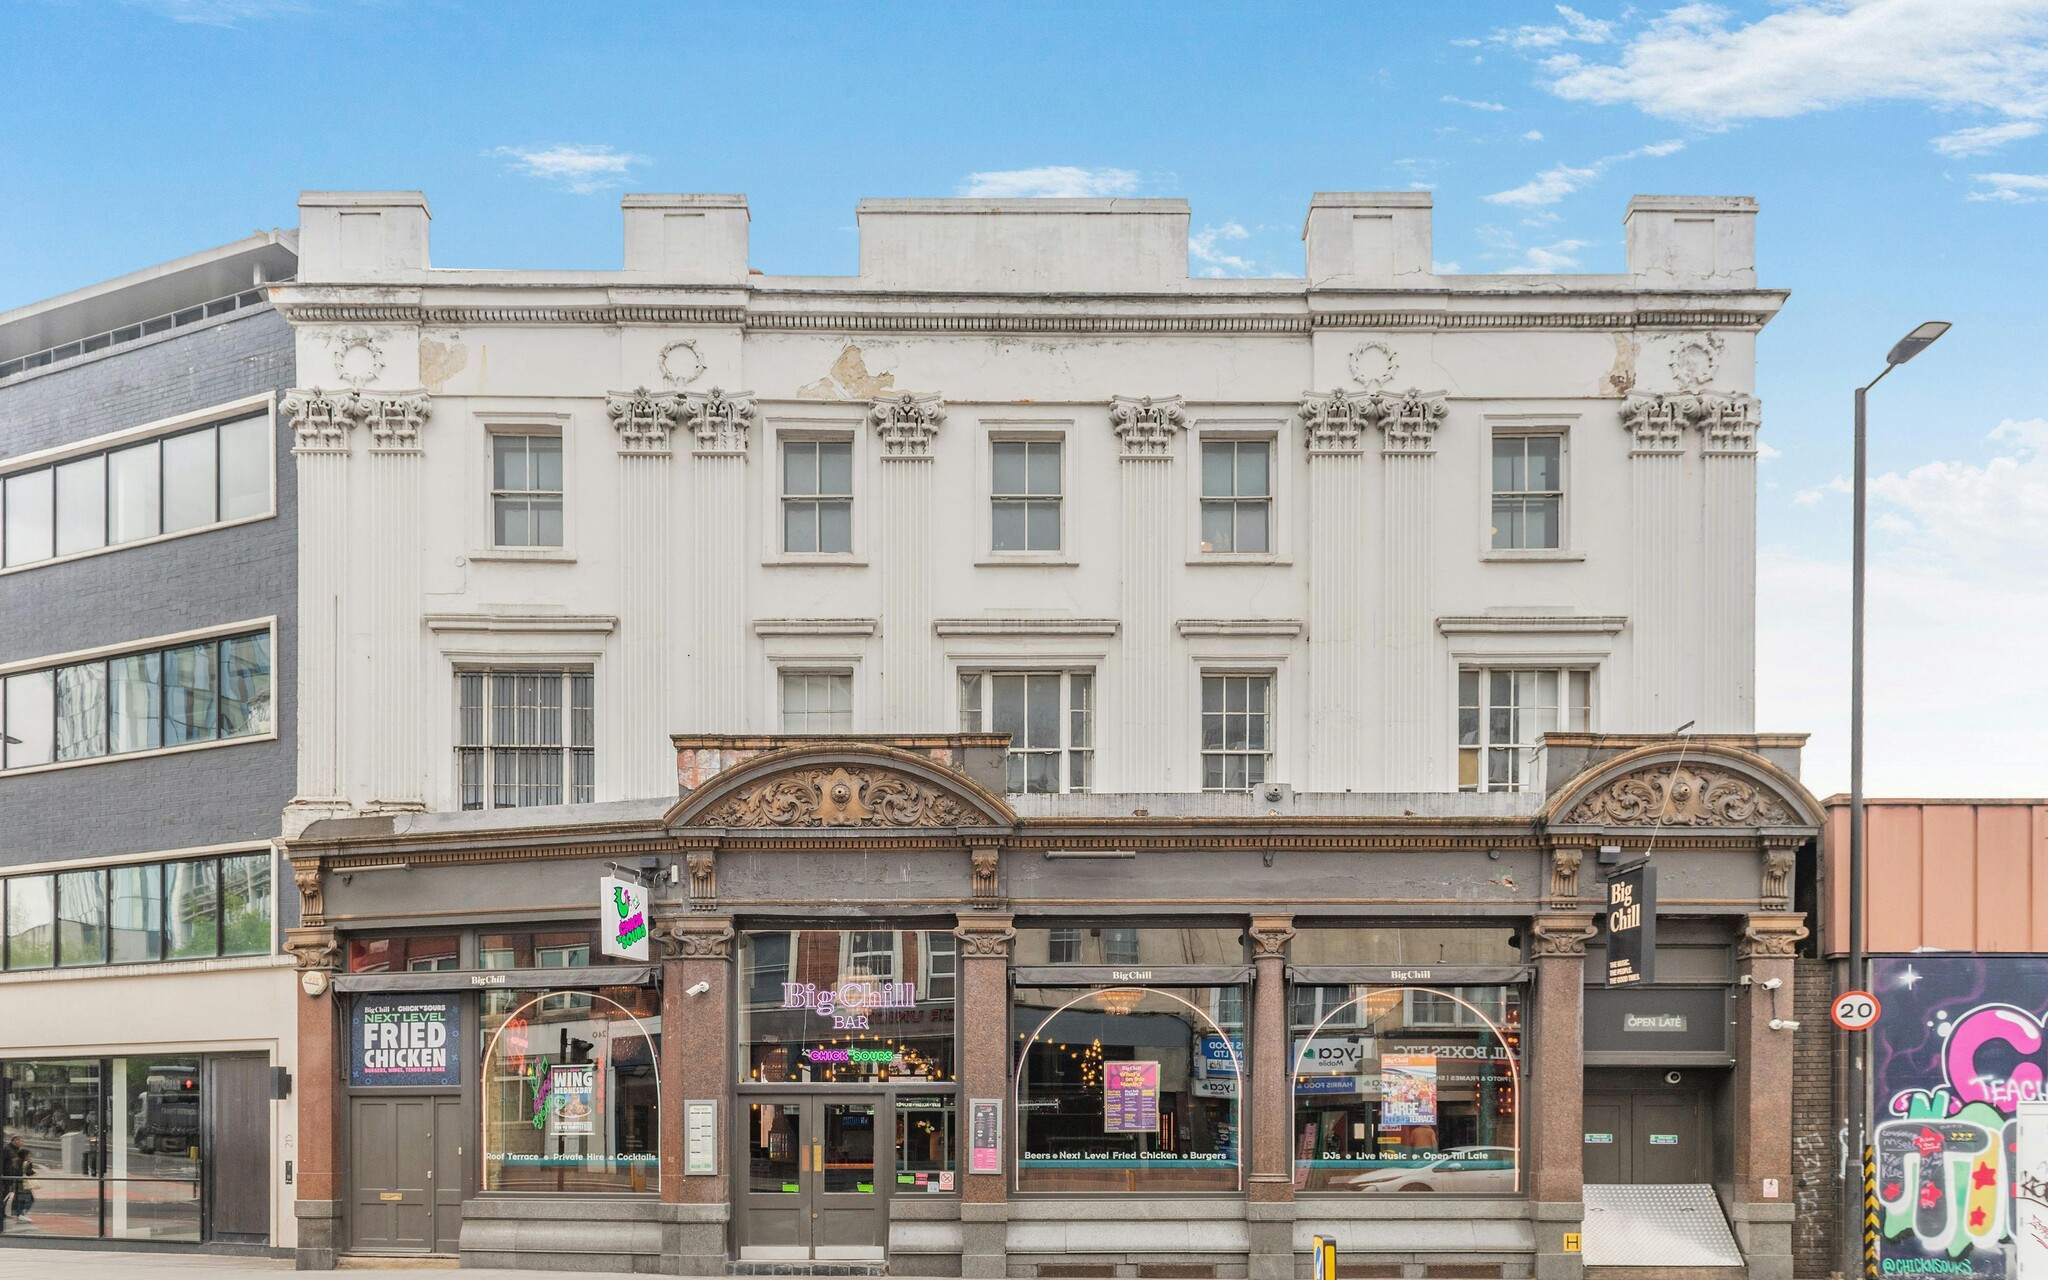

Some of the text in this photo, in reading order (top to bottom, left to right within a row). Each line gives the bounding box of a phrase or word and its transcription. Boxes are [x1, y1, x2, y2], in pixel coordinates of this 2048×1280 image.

[1610, 881, 1633, 907] Big
[618, 911, 644, 936] CHICK
[1610, 903, 1641, 933] Chill
[1840, 1002, 1872, 1018] 20
[364, 1013, 446, 1023] NEXT LEVEL
[833, 1015, 869, 1030] BAR
[1627, 1015, 1682, 1028] OPEN LATE
[364, 1022, 446, 1049] FRIED
[364, 1049, 446, 1068] CHICKEN
[809, 1050, 848, 1062] CHICK
[852, 1051, 893, 1062] SOURS
[554, 1072, 593, 1087] WING
[1385, 1102, 1419, 1116] LARGE
[1410, 1114, 1434, 1123] TERRACE
[487, 1152, 656, 1161] Roof Terrace Private Hire Cocktails
[1025, 1151, 1226, 1161] Beers Next Level Fried Chicken Burgers
[1323, 1152, 1488, 1162] DJs Live Music Open Till Late
[1566, 1235, 1579, 1249] H
